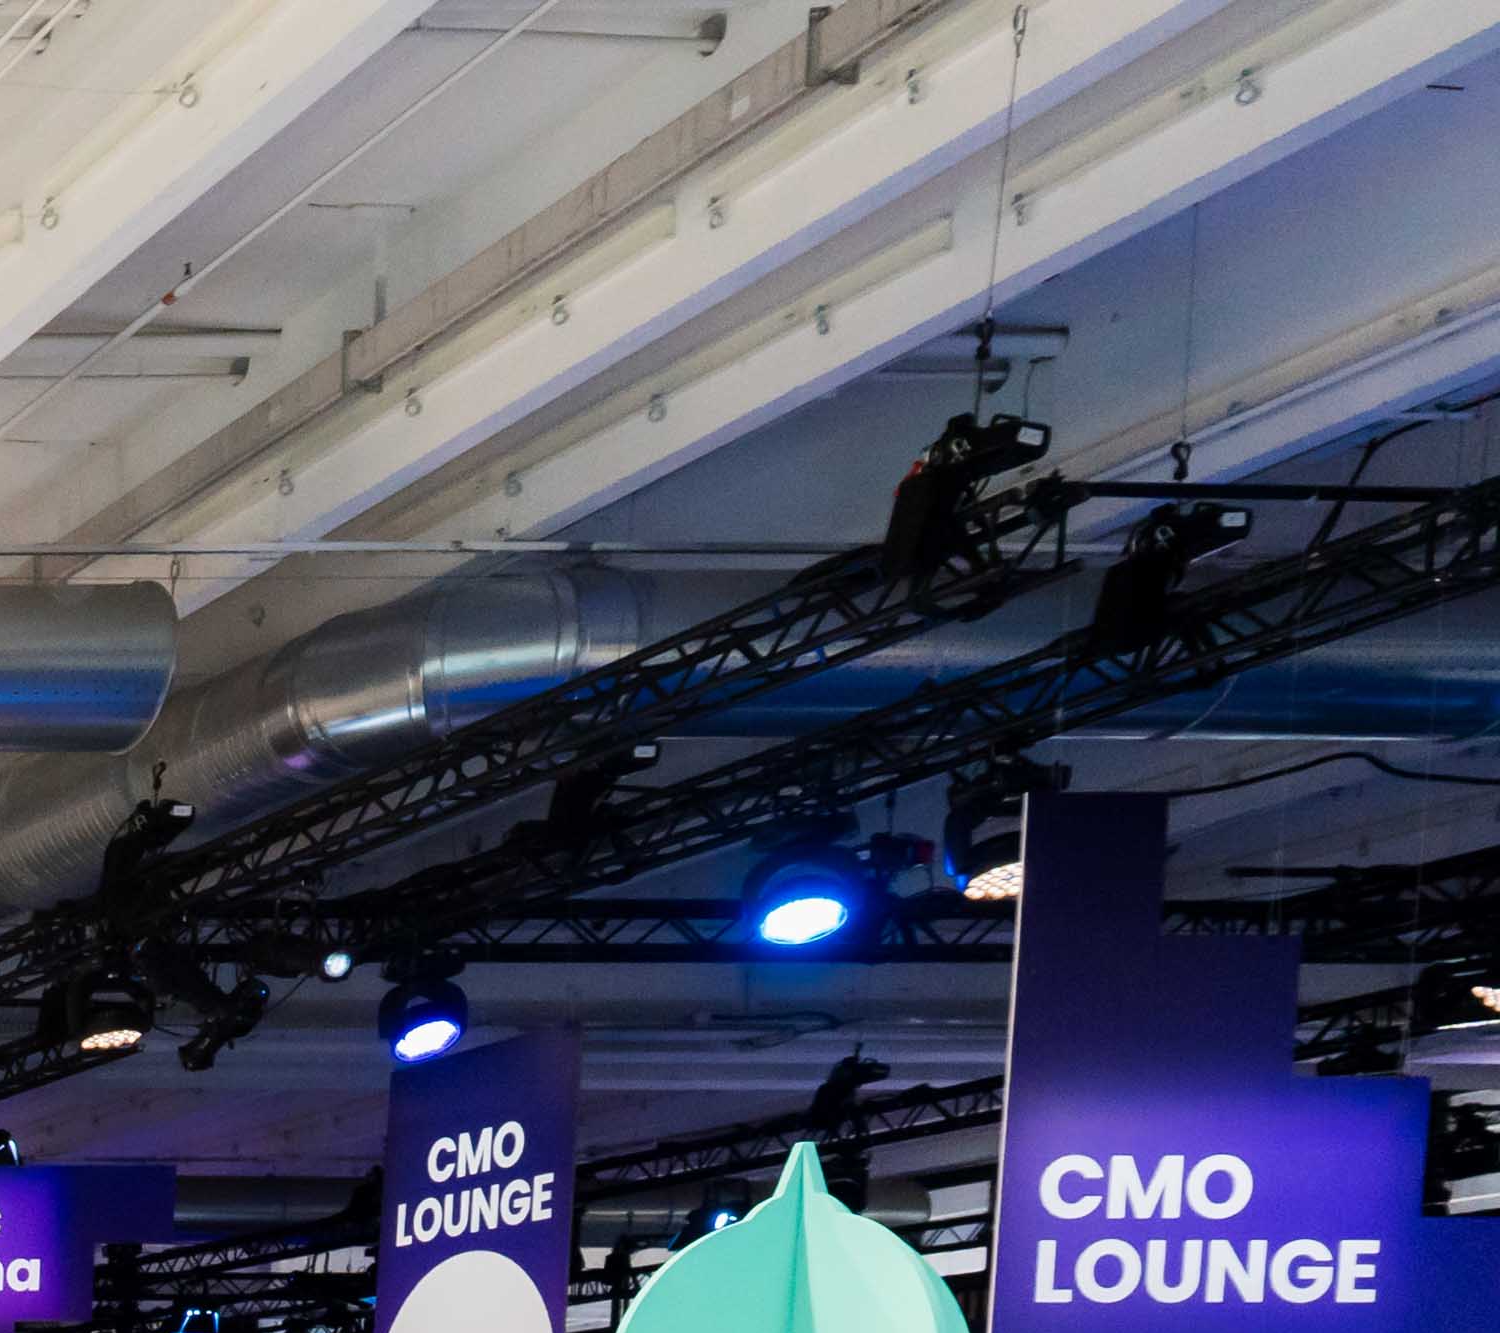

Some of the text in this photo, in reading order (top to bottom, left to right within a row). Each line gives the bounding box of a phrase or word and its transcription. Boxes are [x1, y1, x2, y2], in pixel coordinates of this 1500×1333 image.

[428, 1120, 526, 1184] CMO
[395, 1172, 554, 1248] LOUNGE
[1039, 1153, 1254, 1220] CMO
[1033, 1239, 1381, 1304] LOUNGE
